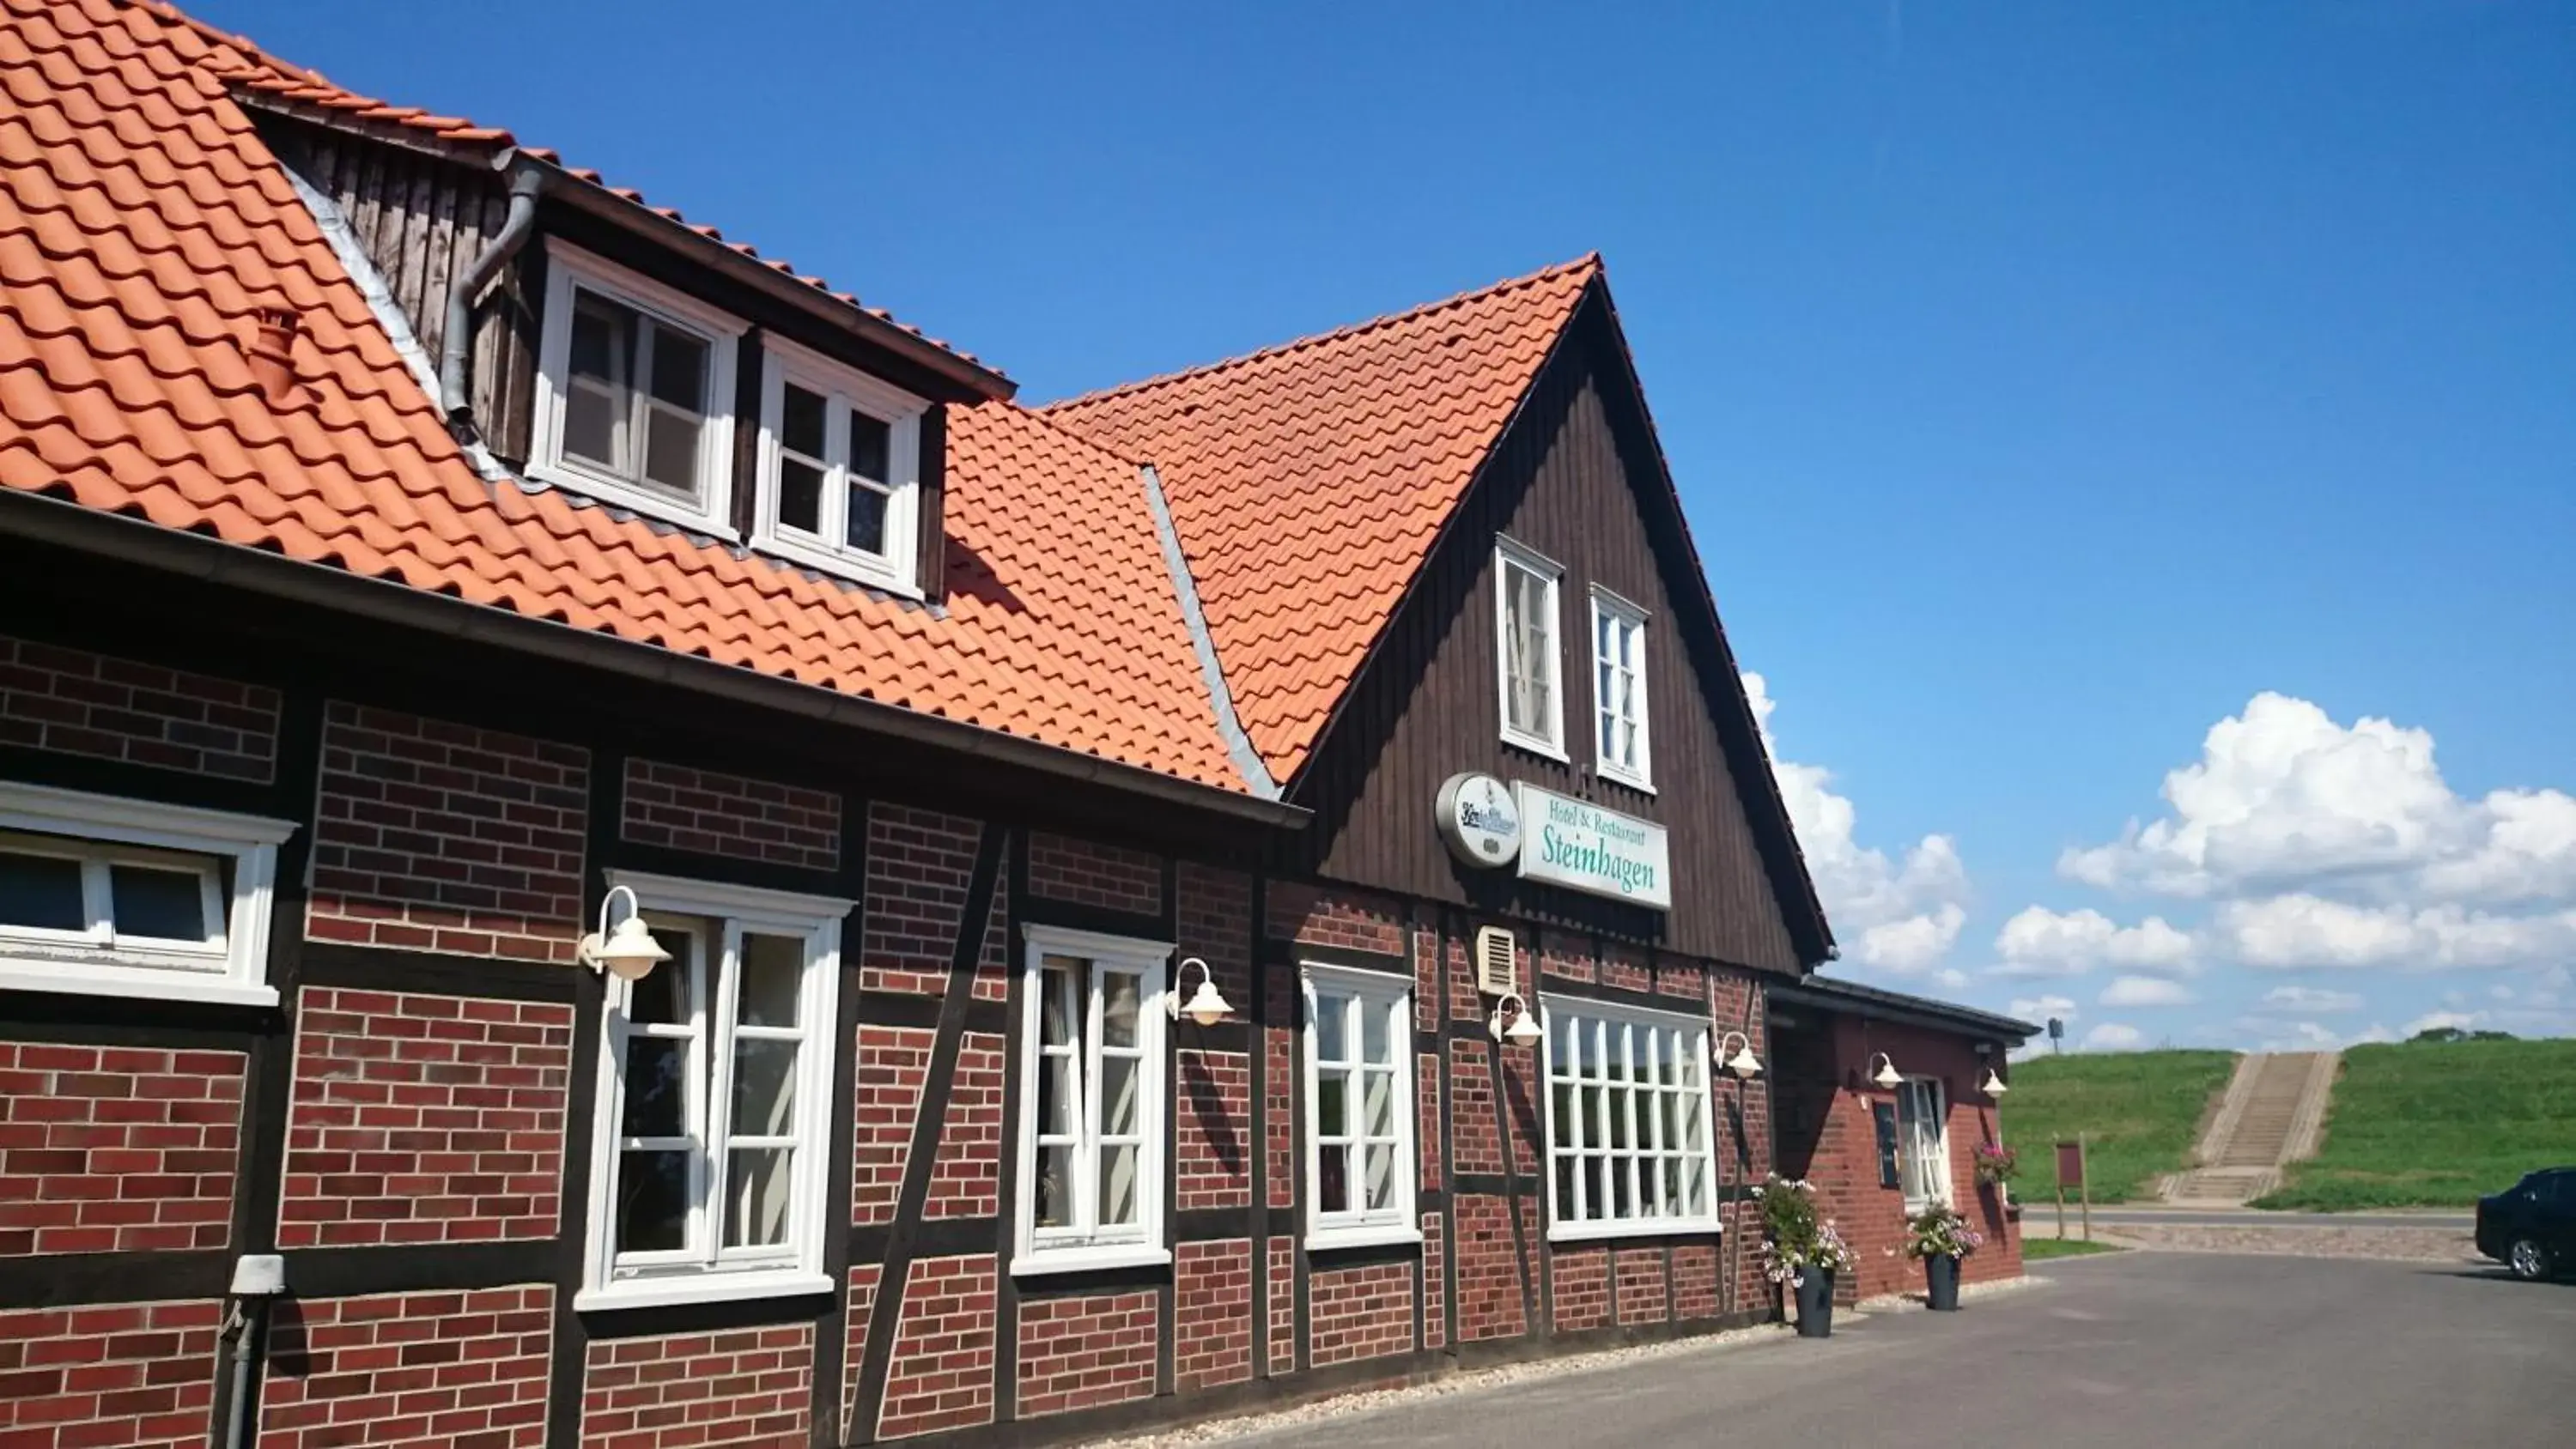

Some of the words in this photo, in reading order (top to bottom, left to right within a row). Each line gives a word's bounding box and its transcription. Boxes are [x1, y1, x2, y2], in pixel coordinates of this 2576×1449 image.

[1550, 799, 1577, 826] Hotel
[1580, 812, 1590, 827] &
[1595, 814, 1647, 846] Restaurant
[1542, 825, 1654, 894] Steinhagen
